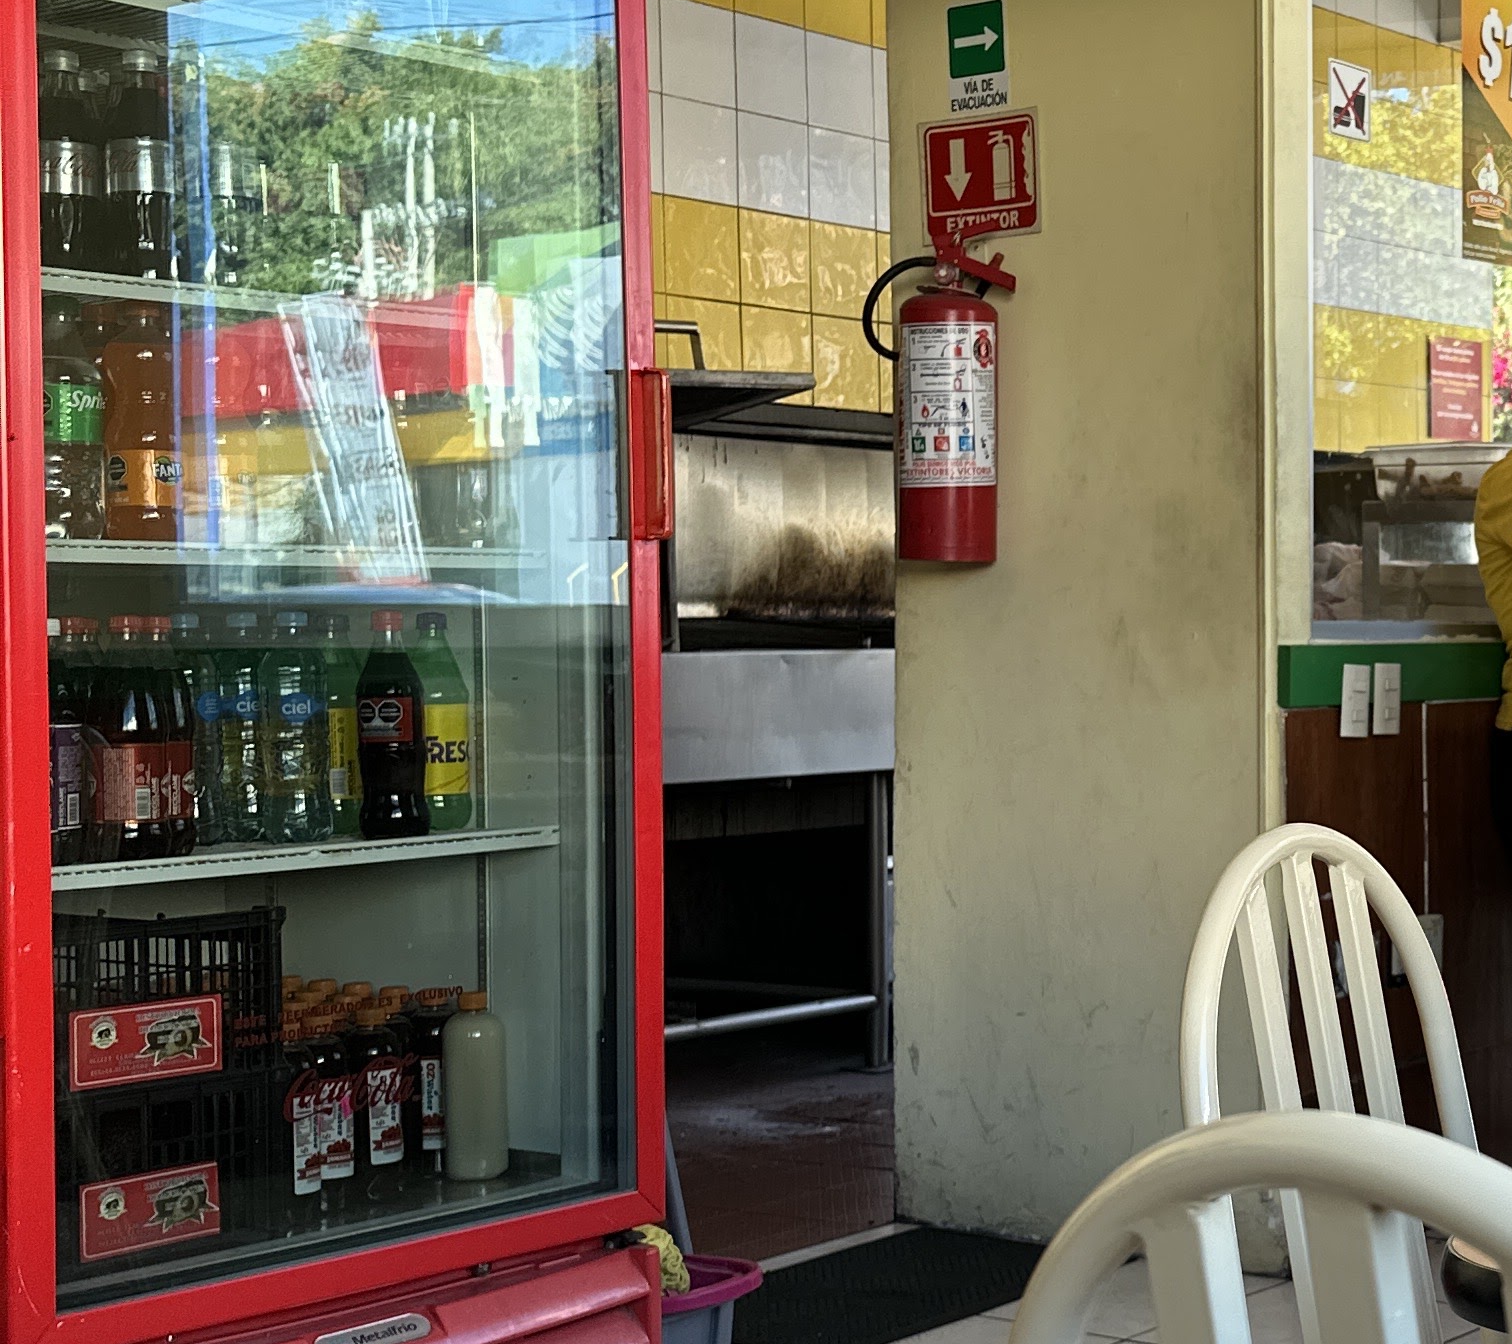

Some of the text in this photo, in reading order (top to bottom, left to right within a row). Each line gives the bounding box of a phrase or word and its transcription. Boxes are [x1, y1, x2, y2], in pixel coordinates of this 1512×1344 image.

[963, 77, 994, 95] VÍA DE
[951, 89, 1008, 113] EVACUACIÓN
[70, 390, 107, 412] Spri
[152, 461, 181, 478] FANT
[236, 696, 260, 713] cie
[281, 698, 312, 716] ciel
[425, 736, 469, 764] FRES
[234, 1014, 267, 1030] ESTE
[379, 997, 393, 1009] ES
[400, 985, 464, 1006] EXCLUSIVO
[235, 1033, 268, 1048] PARA
